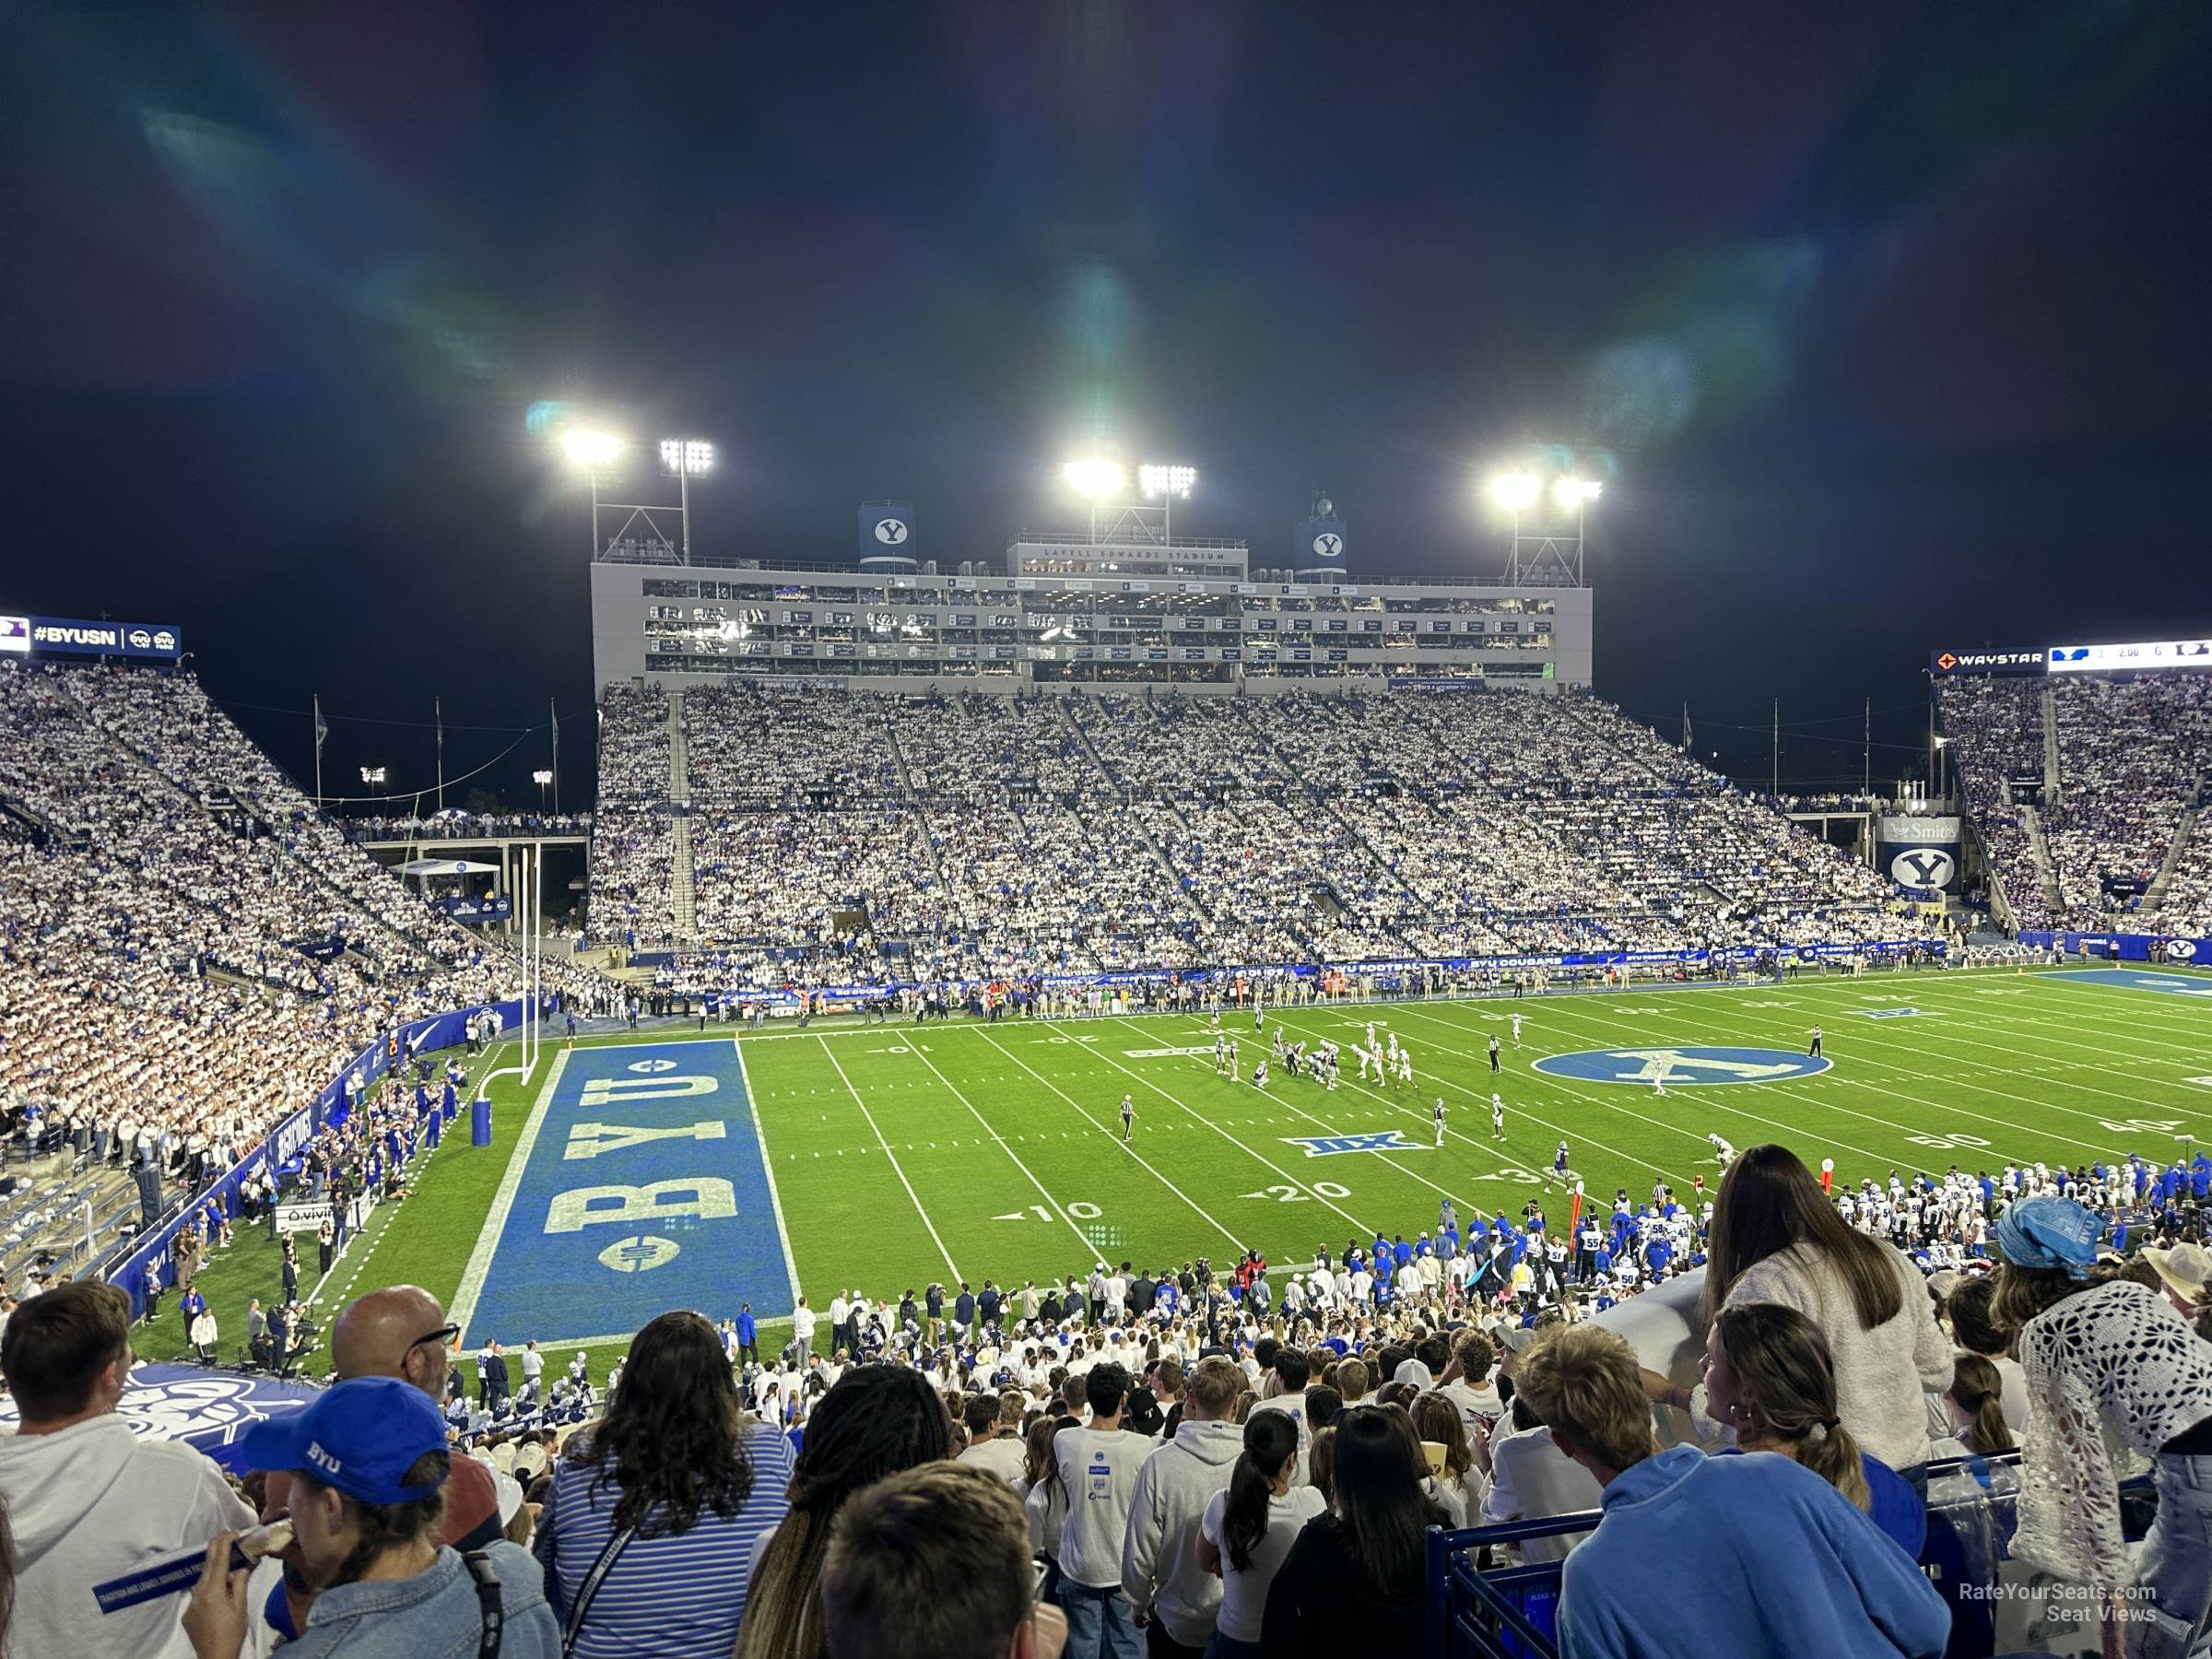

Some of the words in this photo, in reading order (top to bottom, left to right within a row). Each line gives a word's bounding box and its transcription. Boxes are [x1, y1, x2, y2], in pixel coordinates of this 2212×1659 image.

[879, 522, 903, 542] Y
[1319, 535, 1339, 554] Y
[1044, 548, 1090, 558] LAVELL
[1100, 550, 1159, 559] EDWARDS
[1169, 552, 1224, 560] STADIUM
[34, 626, 116, 646] #BYUSN
[1958, 653, 2043, 666] WAYSTAR
[1901, 853, 1947, 885] Y
[2171, 942, 2192, 956] Y
[1359, 961, 1420, 971] FOOTBAL
[1492, 957, 1562, 967] COUGARS
[1042, 978, 1083, 986] OOTBALL
[1904, 1133, 1992, 1149] 50
[544, 1076, 737, 1233] BYU
[1695, 1174, 1704, 1188] 2
[1265, 1181, 1352, 1203] 20
[1030, 1201, 1103, 1223] 10
[1653, 1224, 1664, 1234] 58
[2078, 1219, 2096, 1246] BYU
[1587, 1238, 1599, 1248] 55
[1551, 1252, 1561, 1260] 51
[1621, 1275, 1634, 1284] 50
[307, 1441, 342, 1474] BYU
